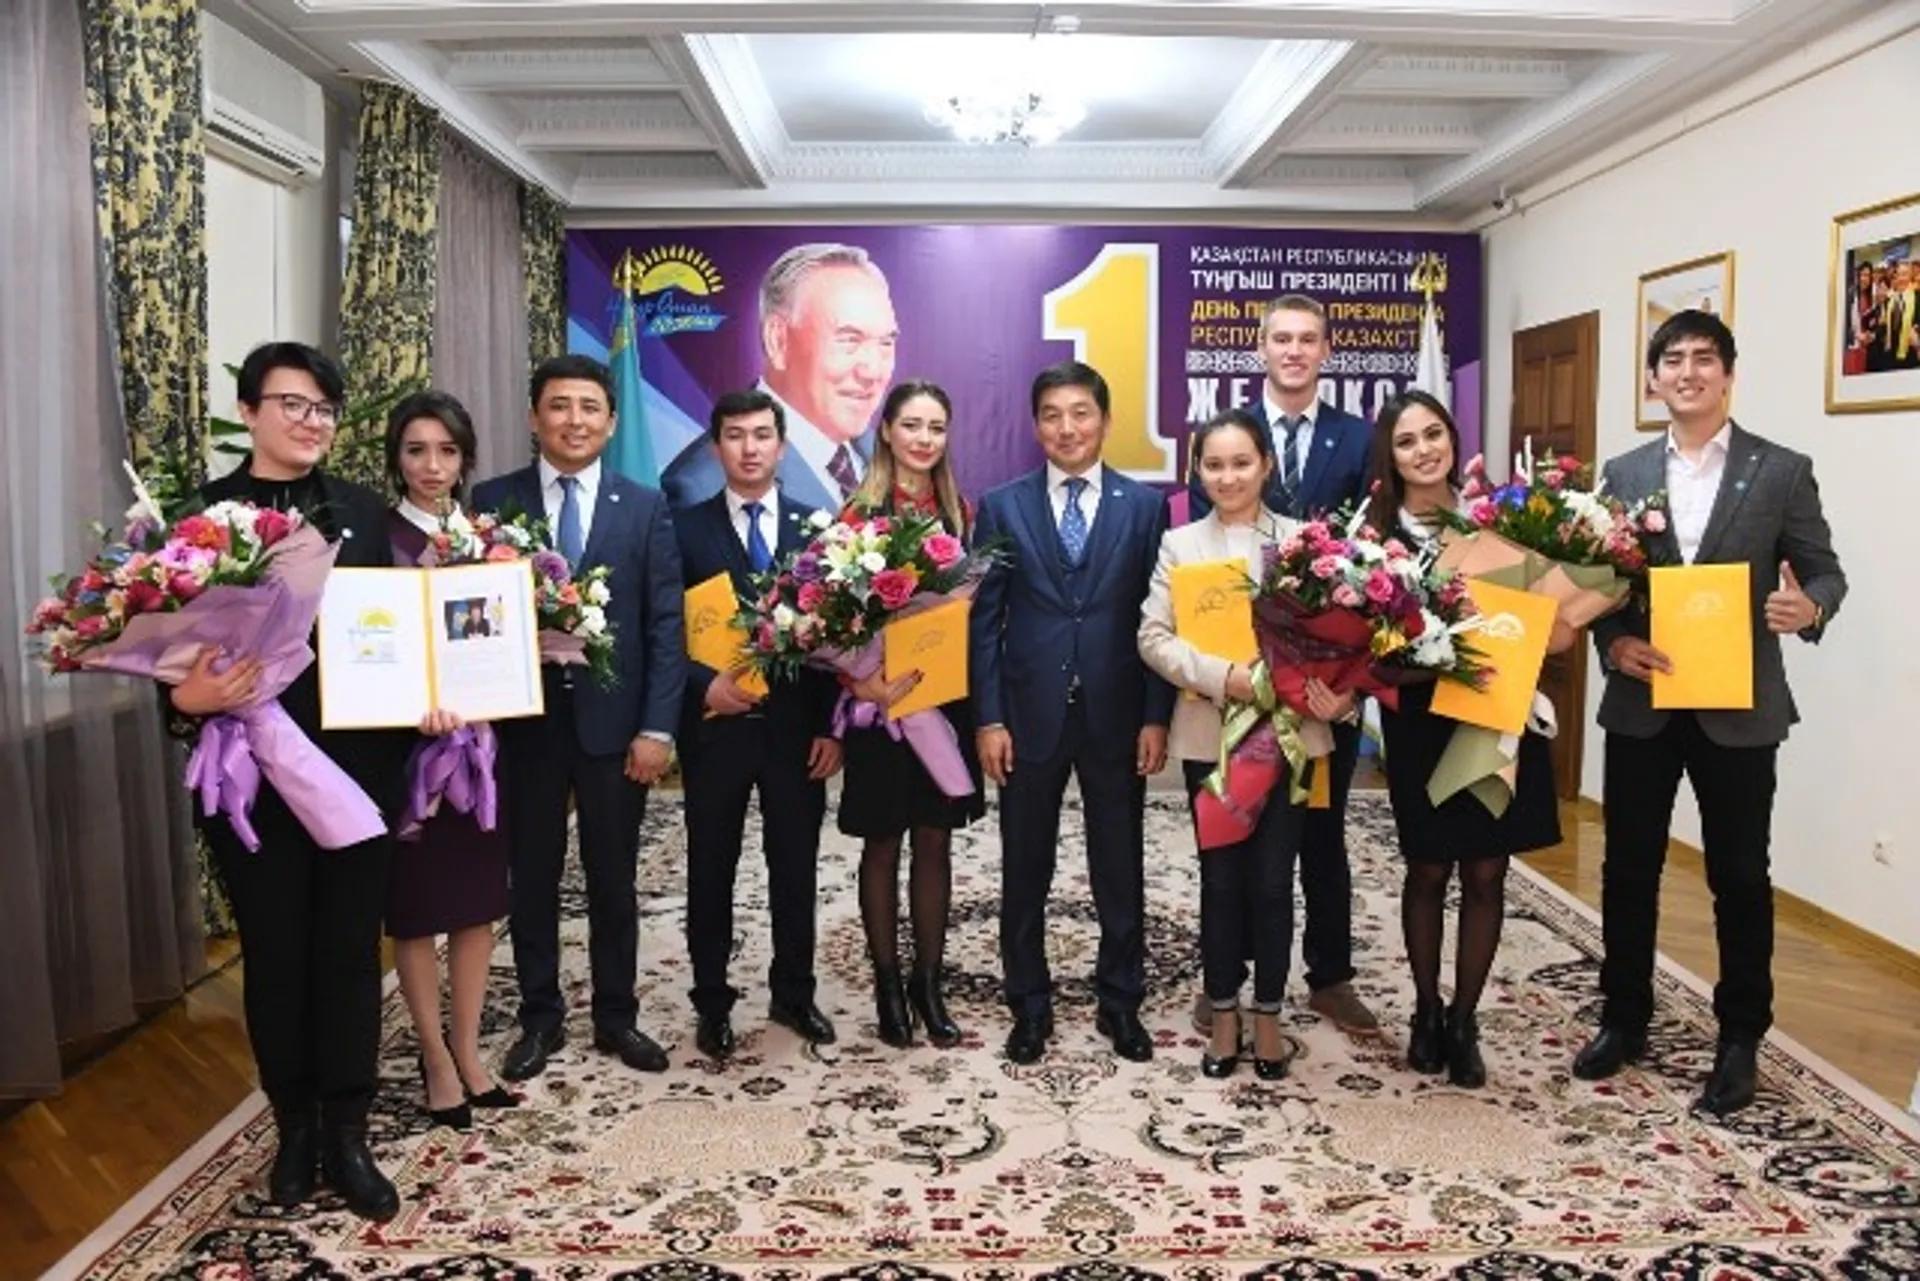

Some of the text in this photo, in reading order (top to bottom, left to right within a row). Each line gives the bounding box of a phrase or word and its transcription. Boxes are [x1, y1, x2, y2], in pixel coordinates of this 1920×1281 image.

[1191, 300, 1240, 322] ДЕНЬ
[1329, 303, 1444, 325] ПРЕЗИДЕНА
[1331, 328, 1444, 348] КАЗАХСТ
[1043, 243, 1177, 482] 1
